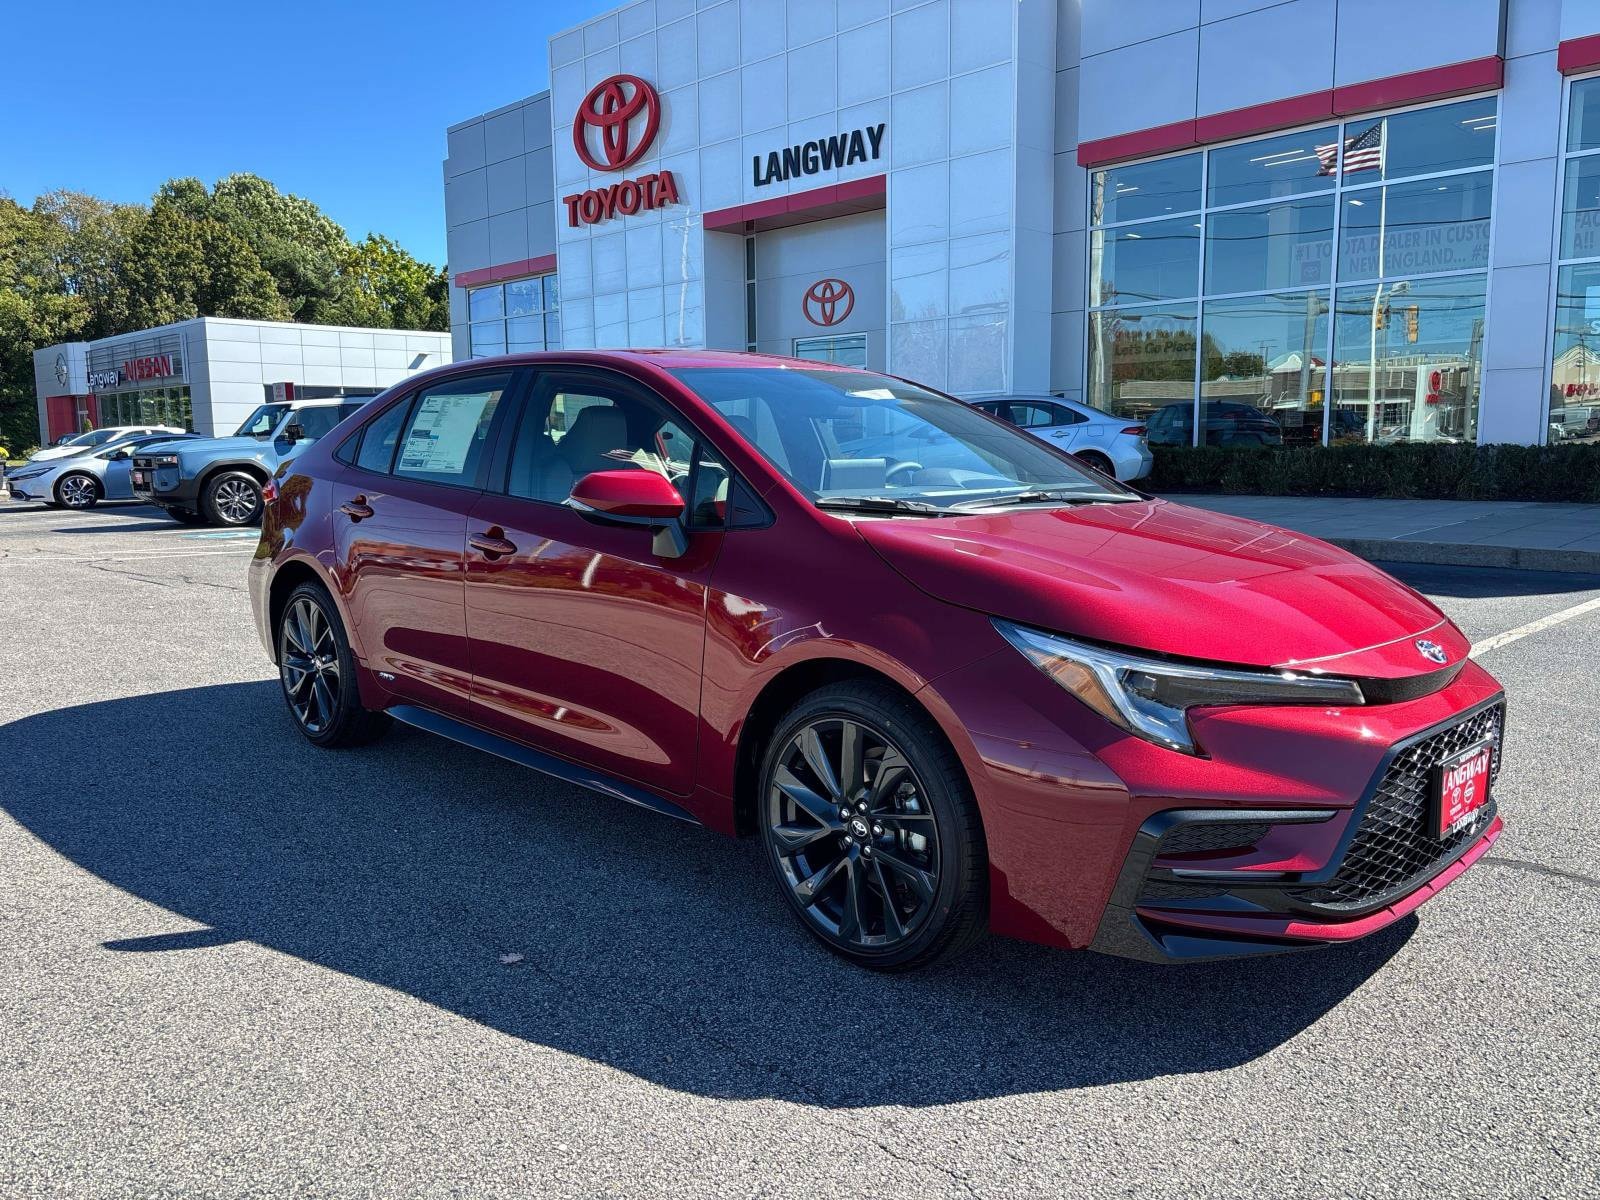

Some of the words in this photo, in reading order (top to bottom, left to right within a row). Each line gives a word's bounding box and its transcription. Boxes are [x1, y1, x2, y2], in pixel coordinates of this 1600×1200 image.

[753, 123, 886, 187] LANGWAY
[563, 170, 679, 228] TOYOTA
[1425, 228, 1441, 245] IN
[124, 354, 174, 380] NISSAN
[1442, 753, 1489, 796] LANGWAY
